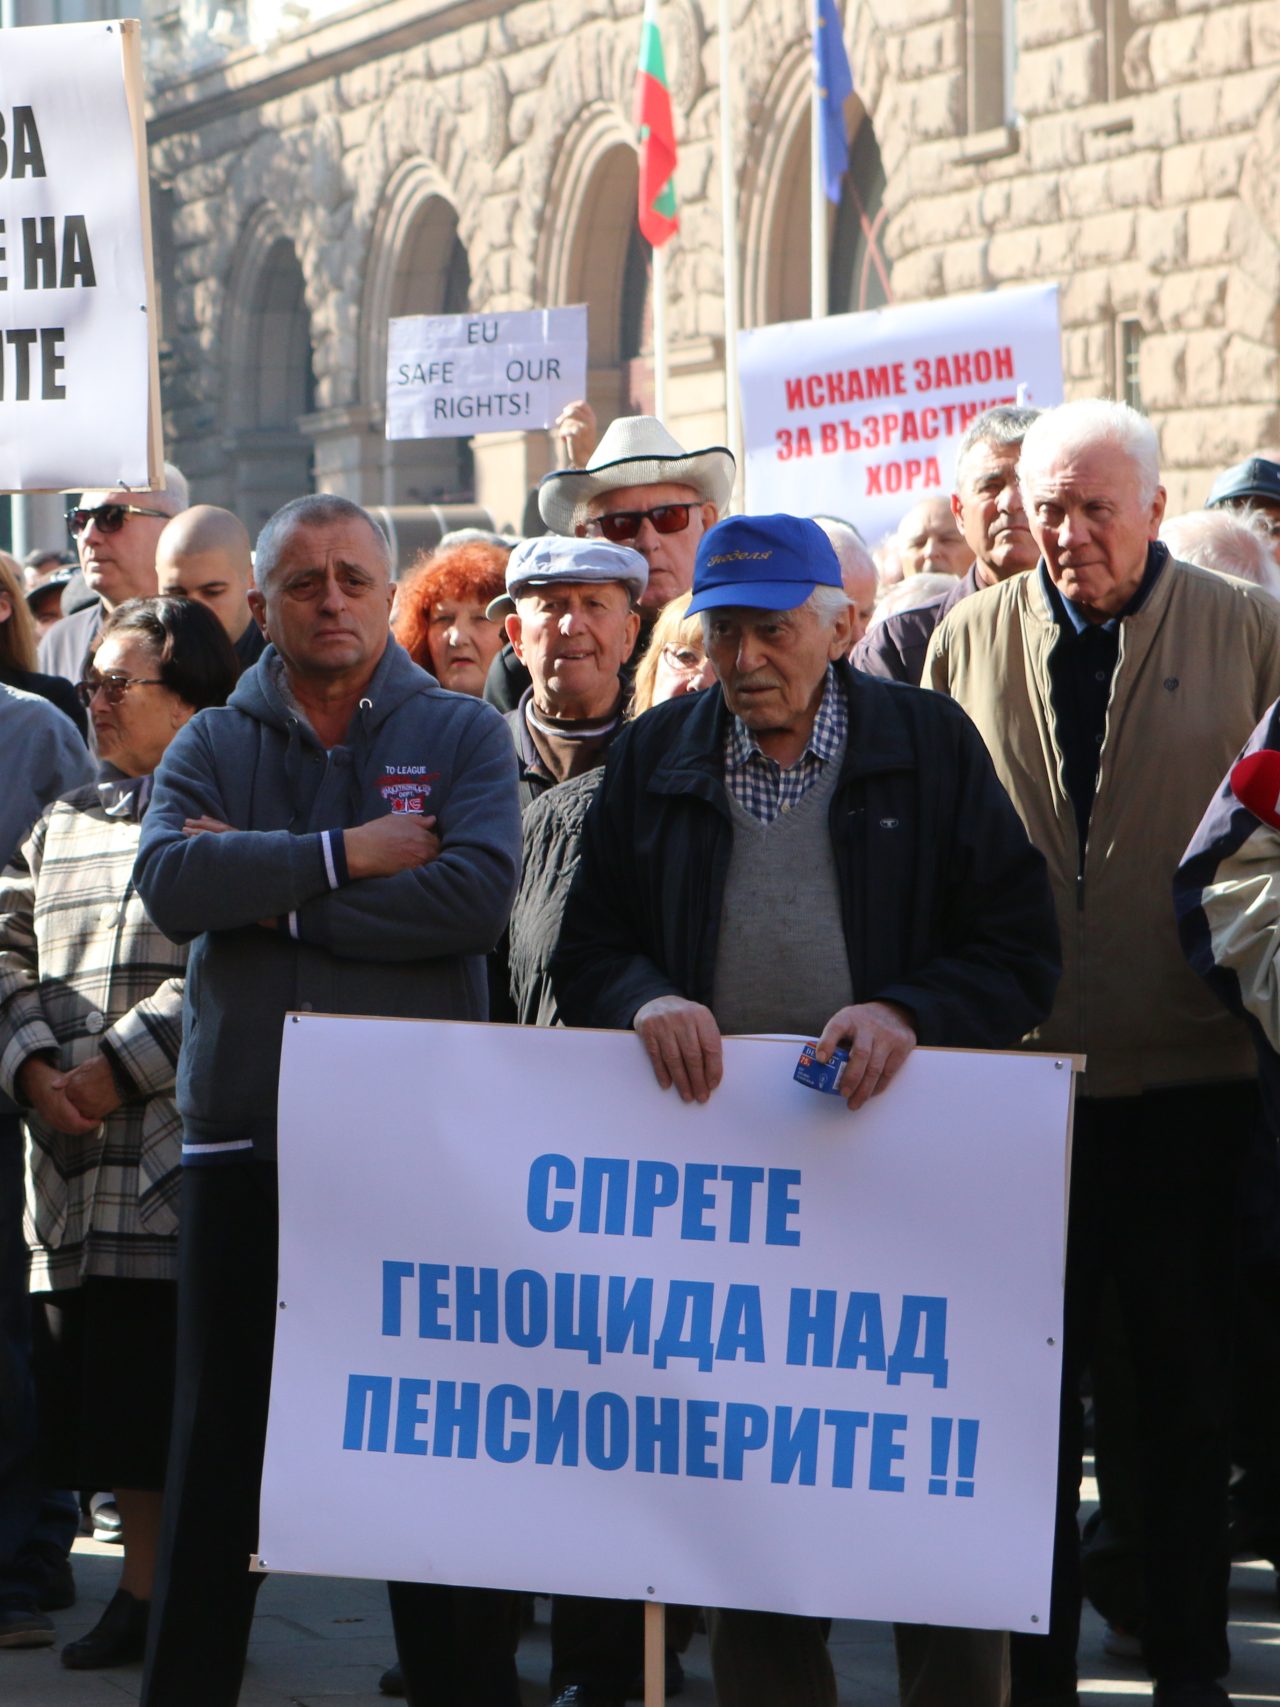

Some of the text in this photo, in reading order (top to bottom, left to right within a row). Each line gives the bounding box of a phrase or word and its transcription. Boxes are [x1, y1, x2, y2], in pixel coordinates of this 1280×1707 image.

[22, 214, 97, 290] НА
[468, 322, 498, 344] EU
[398, 358, 561, 385] SAFE OUR
[784, 346, 1014, 411] ИСКАМЕ ЗАКОН
[434, 392, 530, 419] RIGHTS!
[776, 393, 1032, 462] ЗА ВЪЗРАСТН
[865, 456, 942, 496] ХОРА
[385, 766, 426, 774] TO LEAGUE
[526, 1153, 802, 1247] СПРЕТЕ
[381, 1260, 949, 1388] ГЕНОЦИДА НАД
[342, 1374, 980, 1498] ПЕНСИОНЕРИТЕ !!
